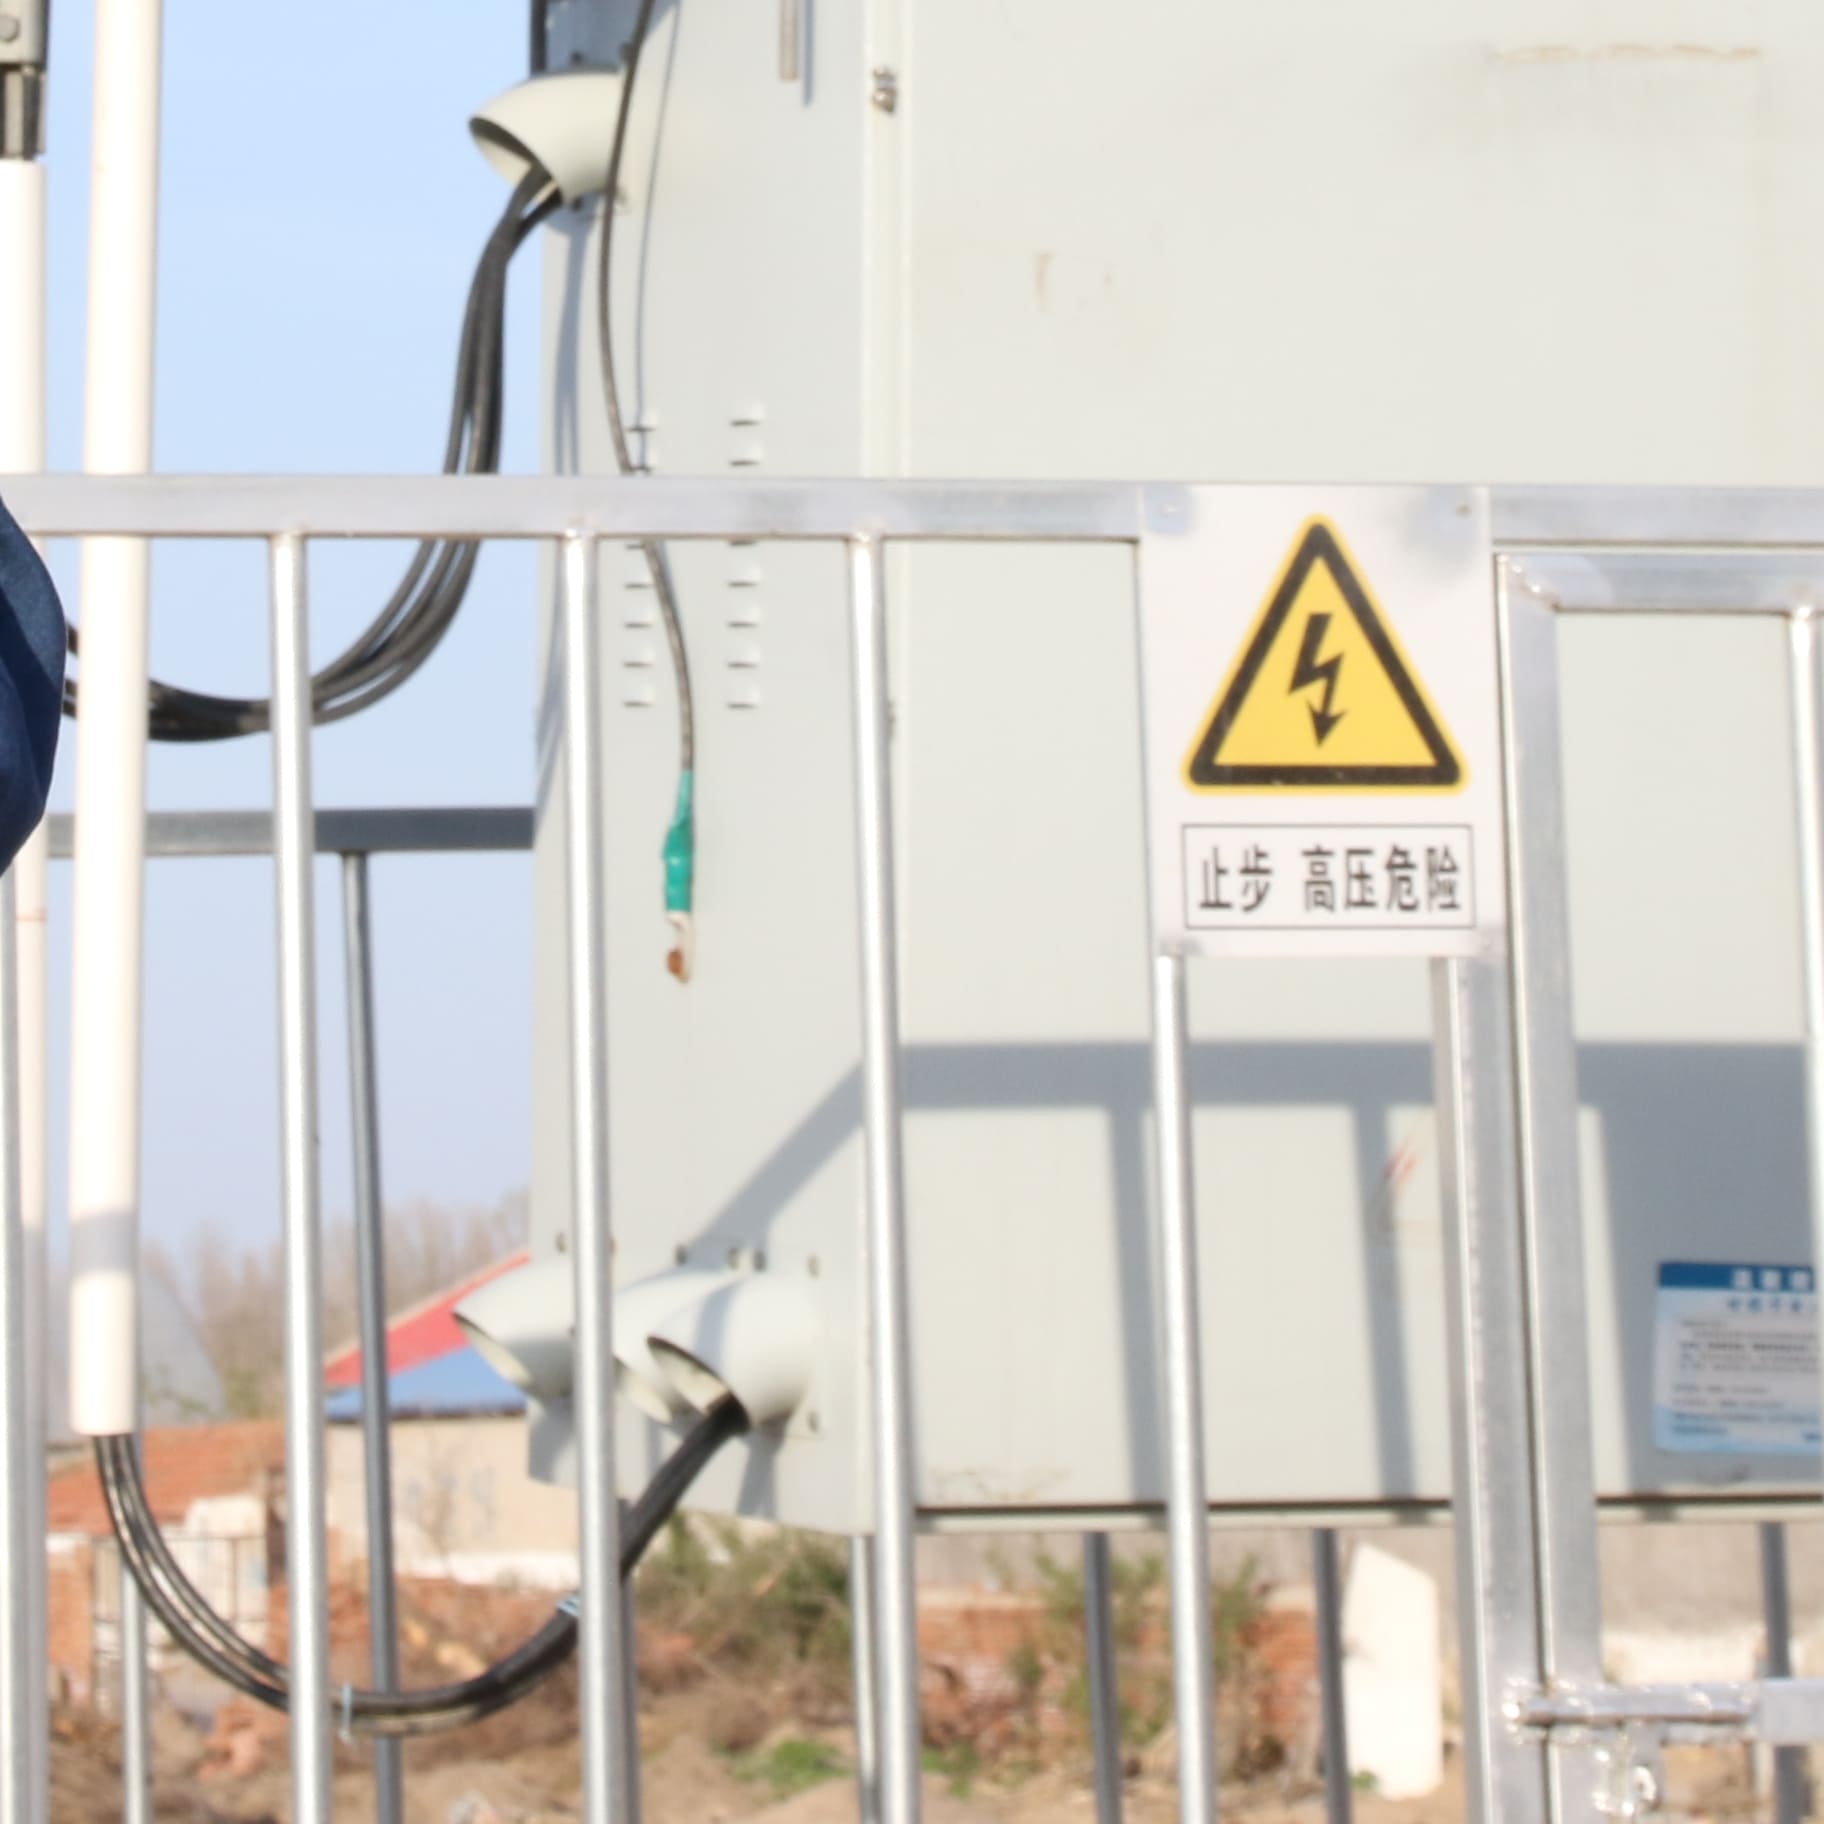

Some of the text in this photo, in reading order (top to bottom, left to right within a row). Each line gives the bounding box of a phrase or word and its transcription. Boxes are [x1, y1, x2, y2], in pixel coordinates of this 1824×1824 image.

[1197, 843, 1462, 914] 止步 高压危险
